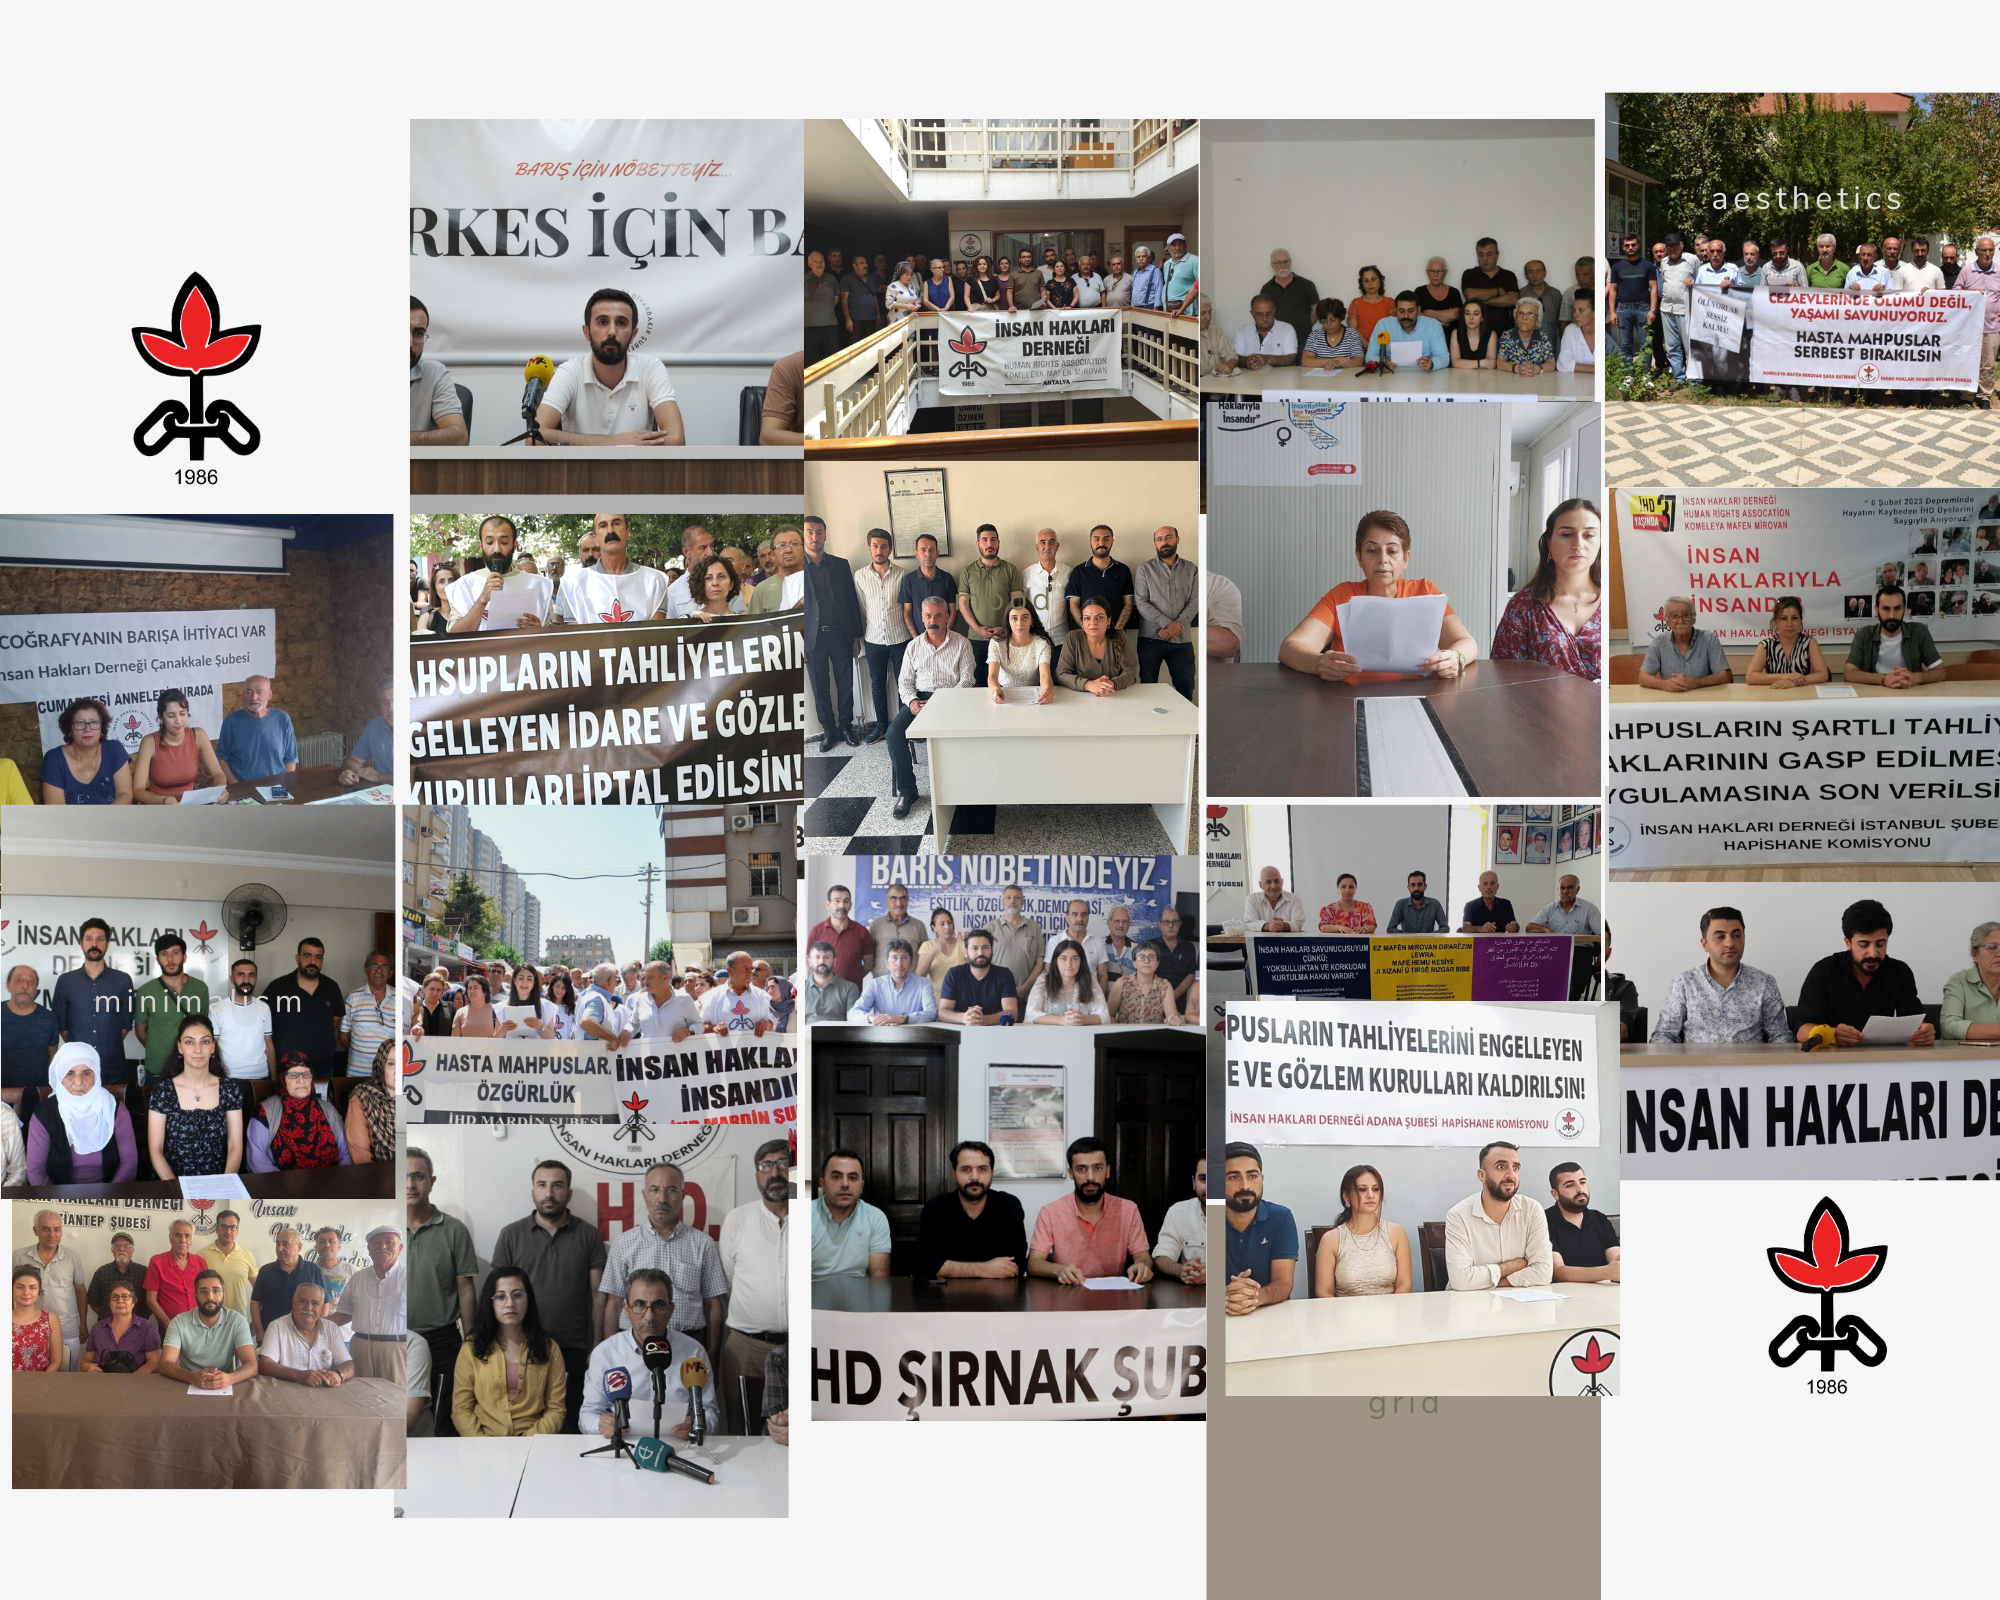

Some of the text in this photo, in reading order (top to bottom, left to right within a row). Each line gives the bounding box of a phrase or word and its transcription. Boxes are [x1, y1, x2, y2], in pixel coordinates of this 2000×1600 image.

[515, 162, 572, 180] BARIŞ
[573, 159, 609, 181] İÇİN
[588, 192, 729, 270] İÇİN
[1697, 296, 1739, 315] ÖLÜYORLAR
[1769, 292, 1972, 311] CEZAEVLERİNDE ÖLÜMÜ DEĞİL,
[1706, 311, 1727, 324] SESSİZ
[1791, 307, 1947, 323] YAŞAMI SAVUNUYORUZ.
[996, 319, 1114, 337] İNSAN HAKLARI
[1703, 321, 1729, 334] KALMA!
[1023, 336, 1089, 356] DERNEĞİ
[1797, 330, 1941, 347] HASTA MAHPUSLAR
[1794, 346, 1941, 362] SERBEST BIRAKILSIN
[1034, 360, 1058, 368] RIGHTS
[1061, 358, 1107, 366] ASSOCIATION
[958, 413, 983, 421] ÖZMEN
[1639, 496, 1655, 513] İHD
[1683, 495, 1776, 505] İNSAN HAKLARI DERNEĞİ
[1879, 499, 1902, 507] Şubat
[1926, 497, 1974, 505] Depreminde
[1657, 495, 1676, 532] 37
[1684, 509, 1710, 518] HUMAN
[1713, 508, 1740, 518] RİGHTS
[1921, 506, 1934, 514] İHD
[1938, 505, 1974, 513] Üyelerini
[1634, 517, 1659, 529] YAŞINDA
[1685, 520, 1787, 530] KOMELEYA MAFEN MİROVAN
[1894, 517, 1927, 525] Saygıyla
[1688, 545, 1759, 564] İNSAN
[1690, 571, 1841, 588] HAKLARIYLA
[0, 625, 266, 649] COĞRAFYANIN BARIŞA İHTİYACI VAR
[39, 665, 91, 678] Hakları
[95, 659, 147, 674] Derneği
[151, 655, 212, 671] Çanakkale
[215, 652, 250, 668] Şubesi
[568, 703, 659, 749] İDARE
[667, 702, 708, 742] VE
[1792, 719, 1895, 741] ŞARTLI
[1778, 746, 2000, 770] GASP EDİLME
[581, 764, 669, 805] İPTAL
[677, 749, 802, 800] EDİLSİN!
[1819, 783, 1879, 801] SON
[1641, 818, 2000, 835] İNSAN HAKLARI DERNEĞİ İSTANBUL ŞUBE
[1724, 837, 1931, 851] HAPİSHANE KOMİSYONU
[402, 908, 422, 923] Nuh
[1259, 945, 1279, 954] İNSAN
[1281, 945, 1310, 954] HAKLARI
[1408, 943, 1437, 951] MIROVAN
[1320, 963, 1366, 971] VE KORKUDAN
[1431, 965, 1455, 973] RIZGAR
[1310, 972, 1329, 980] HAKKI
[1227, 1015, 1583, 1062] PUSLARIN TAHLİYELERİNİ ENGELLEYEN
[436, 1053, 611, 1075] HASTA MAHPUSLAR
[616, 1047, 797, 1081] İNSAN HAKLA
[1244, 1057, 1585, 1100] VE GÖZLEM KURULLARI KALDIRILSIN!
[477, 1083, 576, 1103] ÖZGÜRLÜK
[681, 1073, 797, 1112] İNSANDI
[1230, 1110, 1549, 1130] İNSAN HAKLARI DERNEĞİ ADANA ŞUBESİ HAPİSHANE KOMİSYONU
[1620, 1080, 1948, 1154] NSAN HAKLARI
[557, 1124, 714, 1168] NSAN HAKLARI DERNEĞ
[111, 1216, 150, 1230] ŞUBESİ
[898, 1348, 1099, 1422] ŞIRNAK
